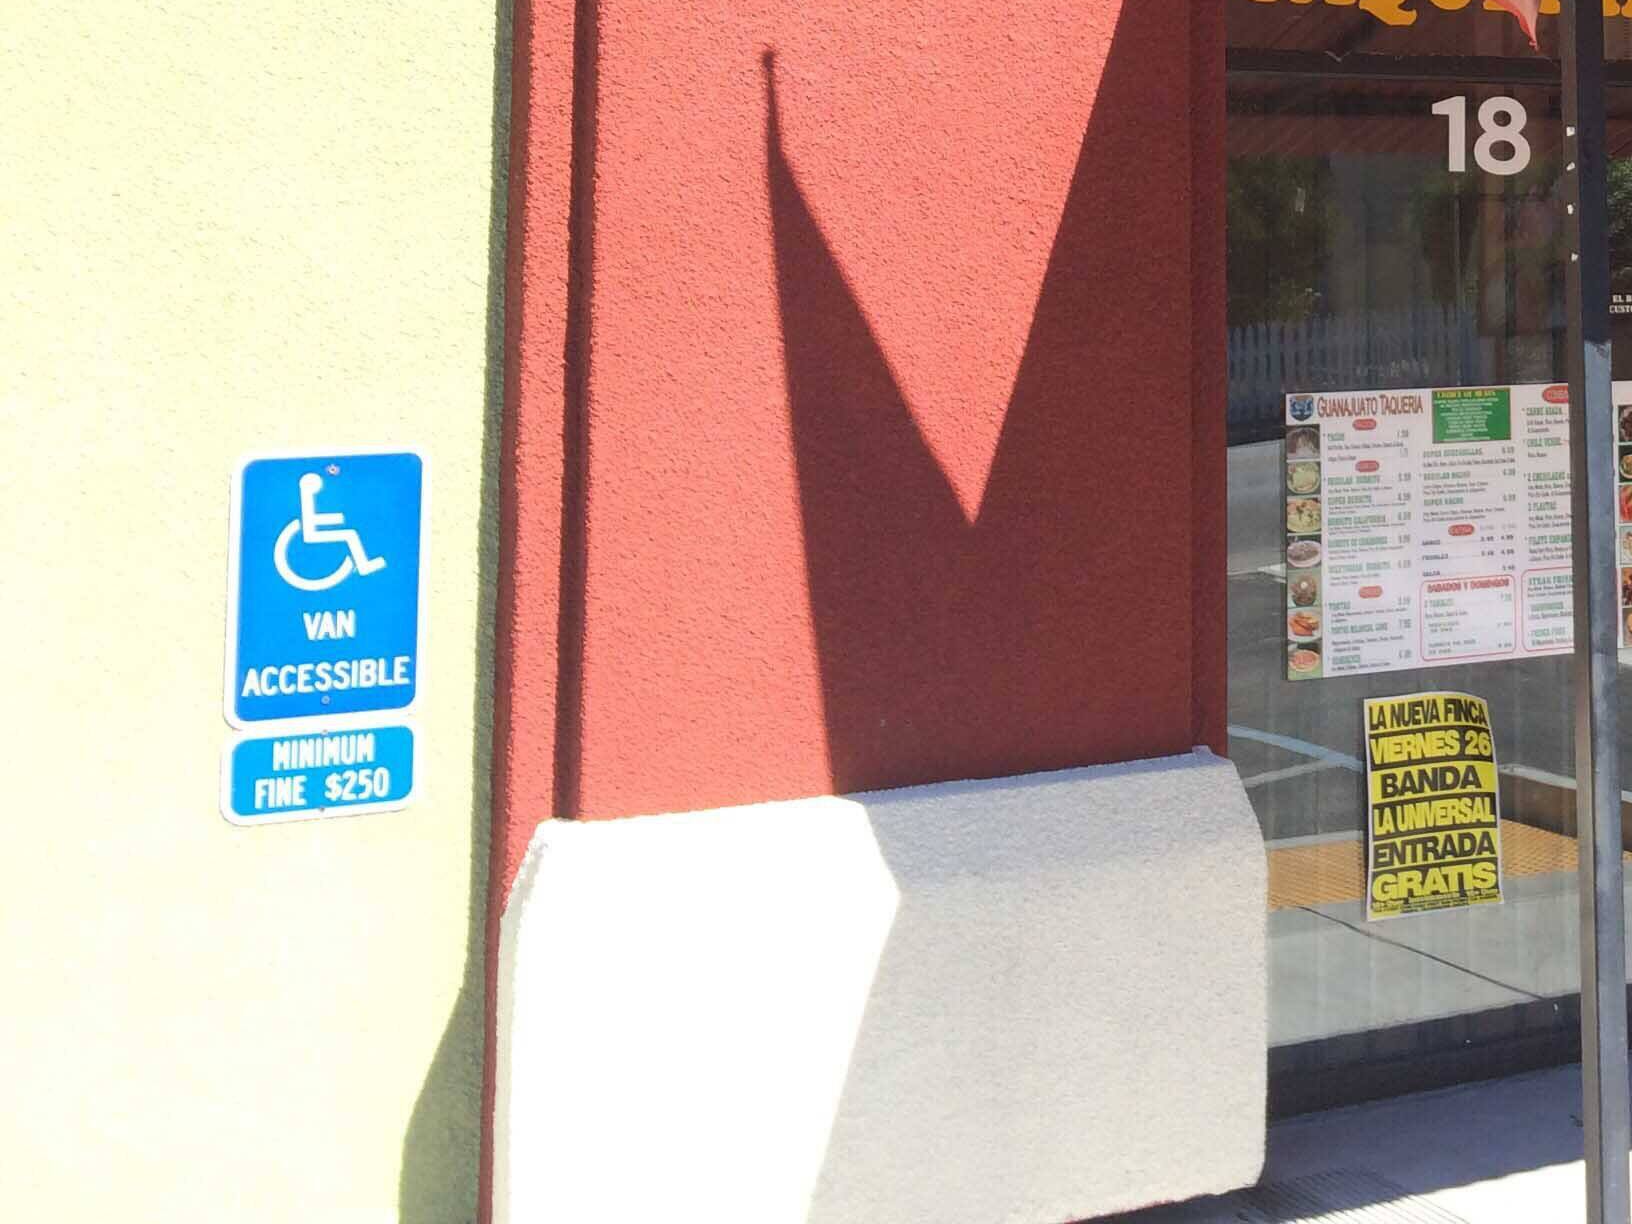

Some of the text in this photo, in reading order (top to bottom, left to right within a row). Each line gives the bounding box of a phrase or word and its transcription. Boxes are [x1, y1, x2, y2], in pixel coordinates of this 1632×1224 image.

[1431, 95, 1531, 176] 18
[1612, 294, 1624, 303] EL
[1317, 393, 1424, 417] GUANAJUATO TAQUERIA
[303, 609, 356, 641] VAN
[241, 655, 411, 698] ACCESSIBLE
[1369, 697, 1488, 731] LA NUEVA FINCA
[272, 733, 375, 772] MINIMUM
[1369, 729, 1493, 765] VIERNES 26
[254, 766, 390, 810] FINE $250
[1381, 764, 1482, 799] BANDA
[1373, 796, 1496, 836] LA UNIVERSAL
[1374, 831, 1496, 869] ENTRADA
[1372, 861, 1498, 902] GRATIS
